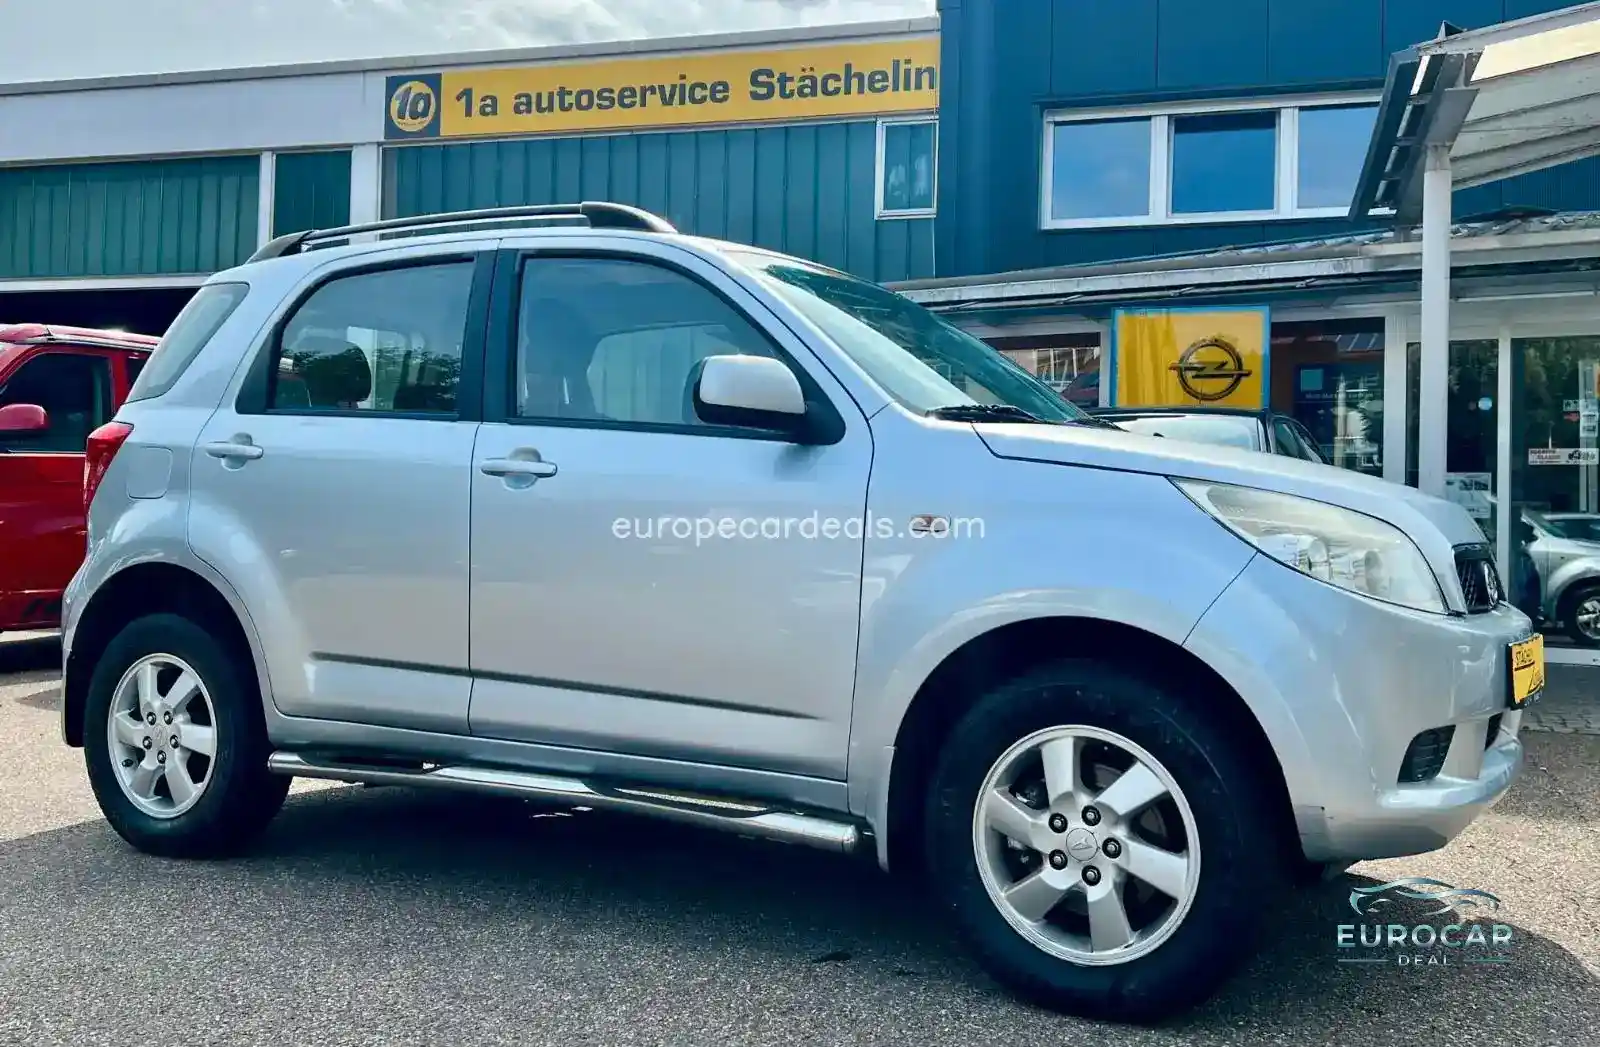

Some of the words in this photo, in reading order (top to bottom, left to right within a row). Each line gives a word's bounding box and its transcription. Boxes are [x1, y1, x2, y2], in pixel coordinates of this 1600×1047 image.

[456, 87, 498, 118] 1a
[513, 73, 730, 115] autoservice
[749, 58, 936, 101] Stächelin
